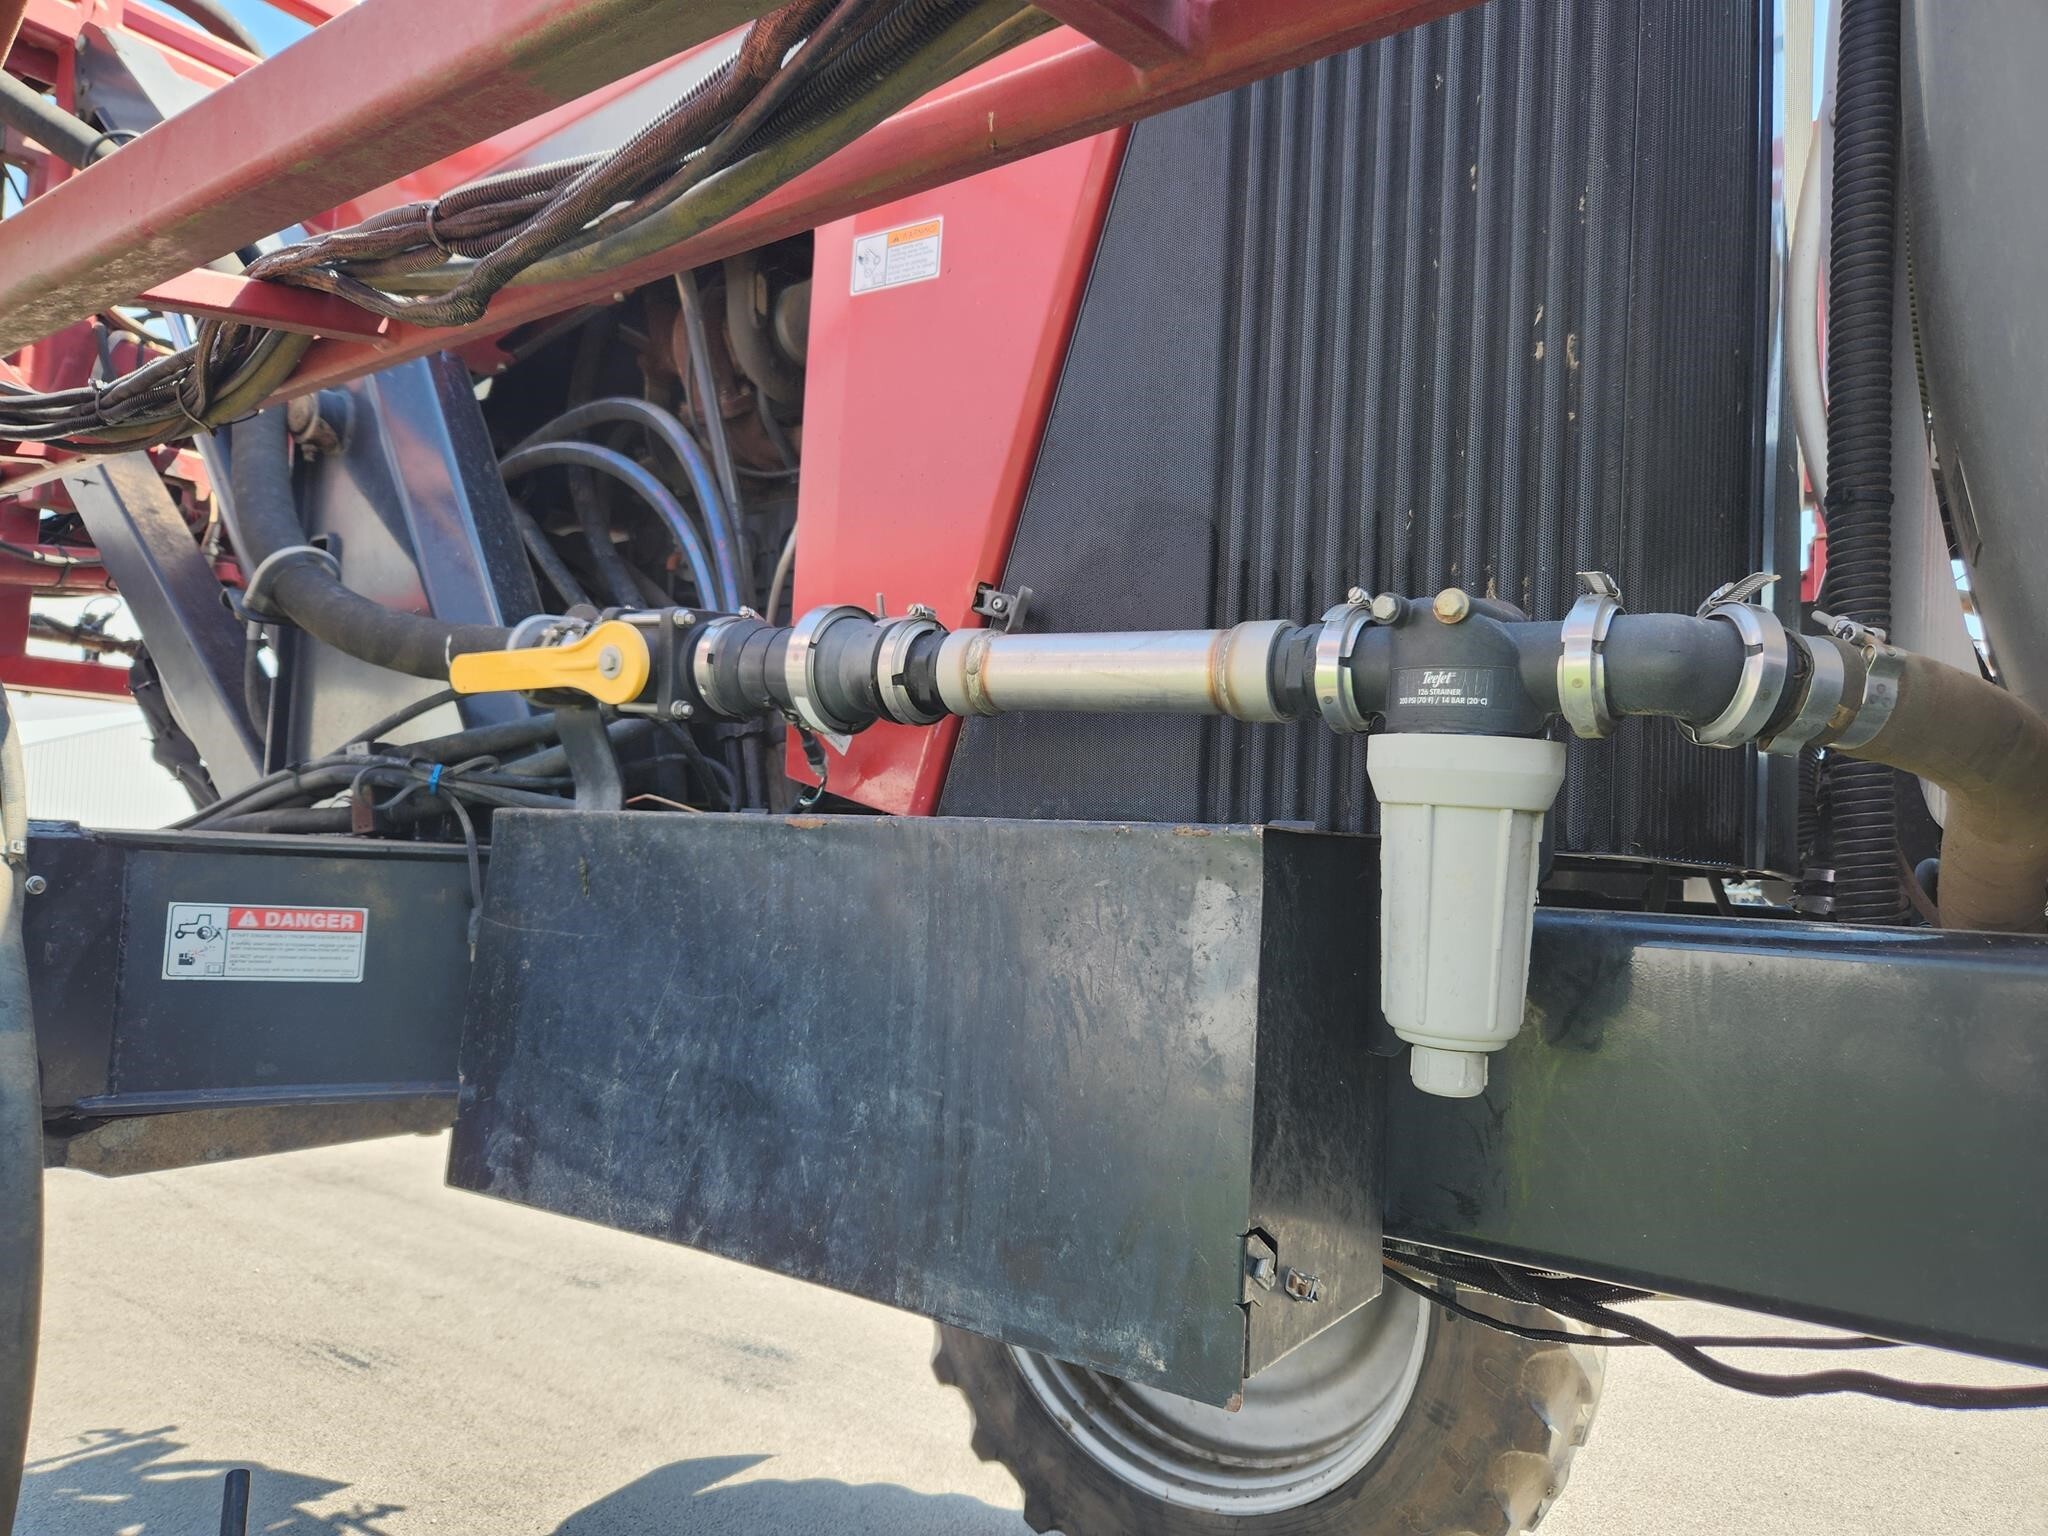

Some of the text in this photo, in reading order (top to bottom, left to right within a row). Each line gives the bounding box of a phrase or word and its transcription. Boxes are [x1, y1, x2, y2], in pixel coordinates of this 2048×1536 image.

[1422, 671, 1456, 688] TeeJet
[1418, 688, 1461, 696] 126 STRAINER
[264, 911, 356, 929] DANGER
